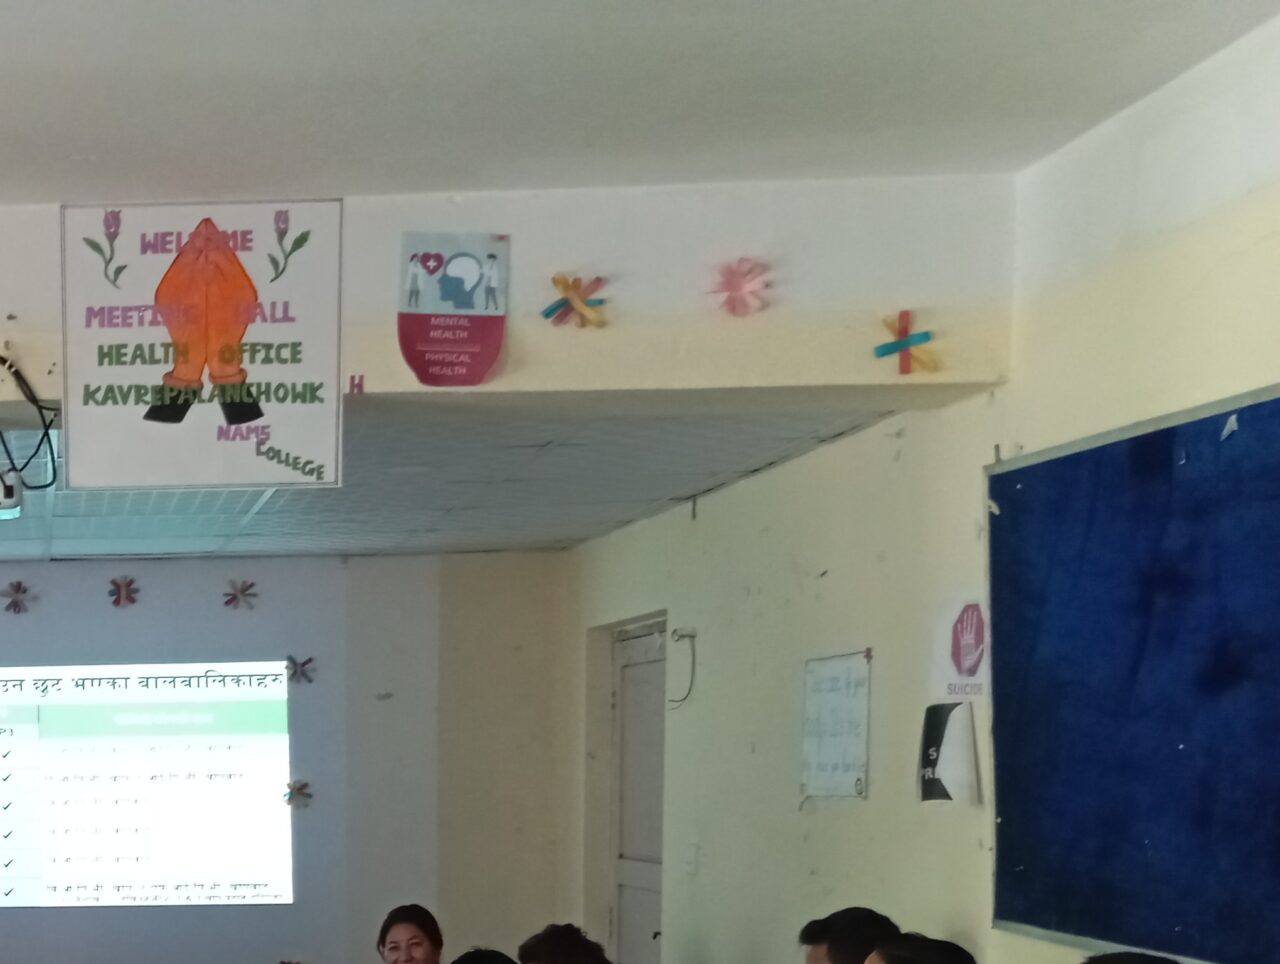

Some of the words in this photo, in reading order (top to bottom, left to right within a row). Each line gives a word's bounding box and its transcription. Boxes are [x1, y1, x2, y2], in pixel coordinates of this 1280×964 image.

[140, 230, 253, 255] WELME
[85, 304, 198, 328] MEETI
[430, 316, 470, 327] MENTAL
[429, 330, 468, 339] HEALTH
[97, 342, 189, 367] HEALTH
[218, 341, 303, 365] OFFICE
[425, 353, 471, 363] PHYSICAL
[428, 366, 466, 376] HEALTH
[349, 374, 364, 395] H
[217, 424, 271, 442] NAMS
[254, 438, 325, 481] COLLEGE
[947, 683, 983, 695] SUICIDE
